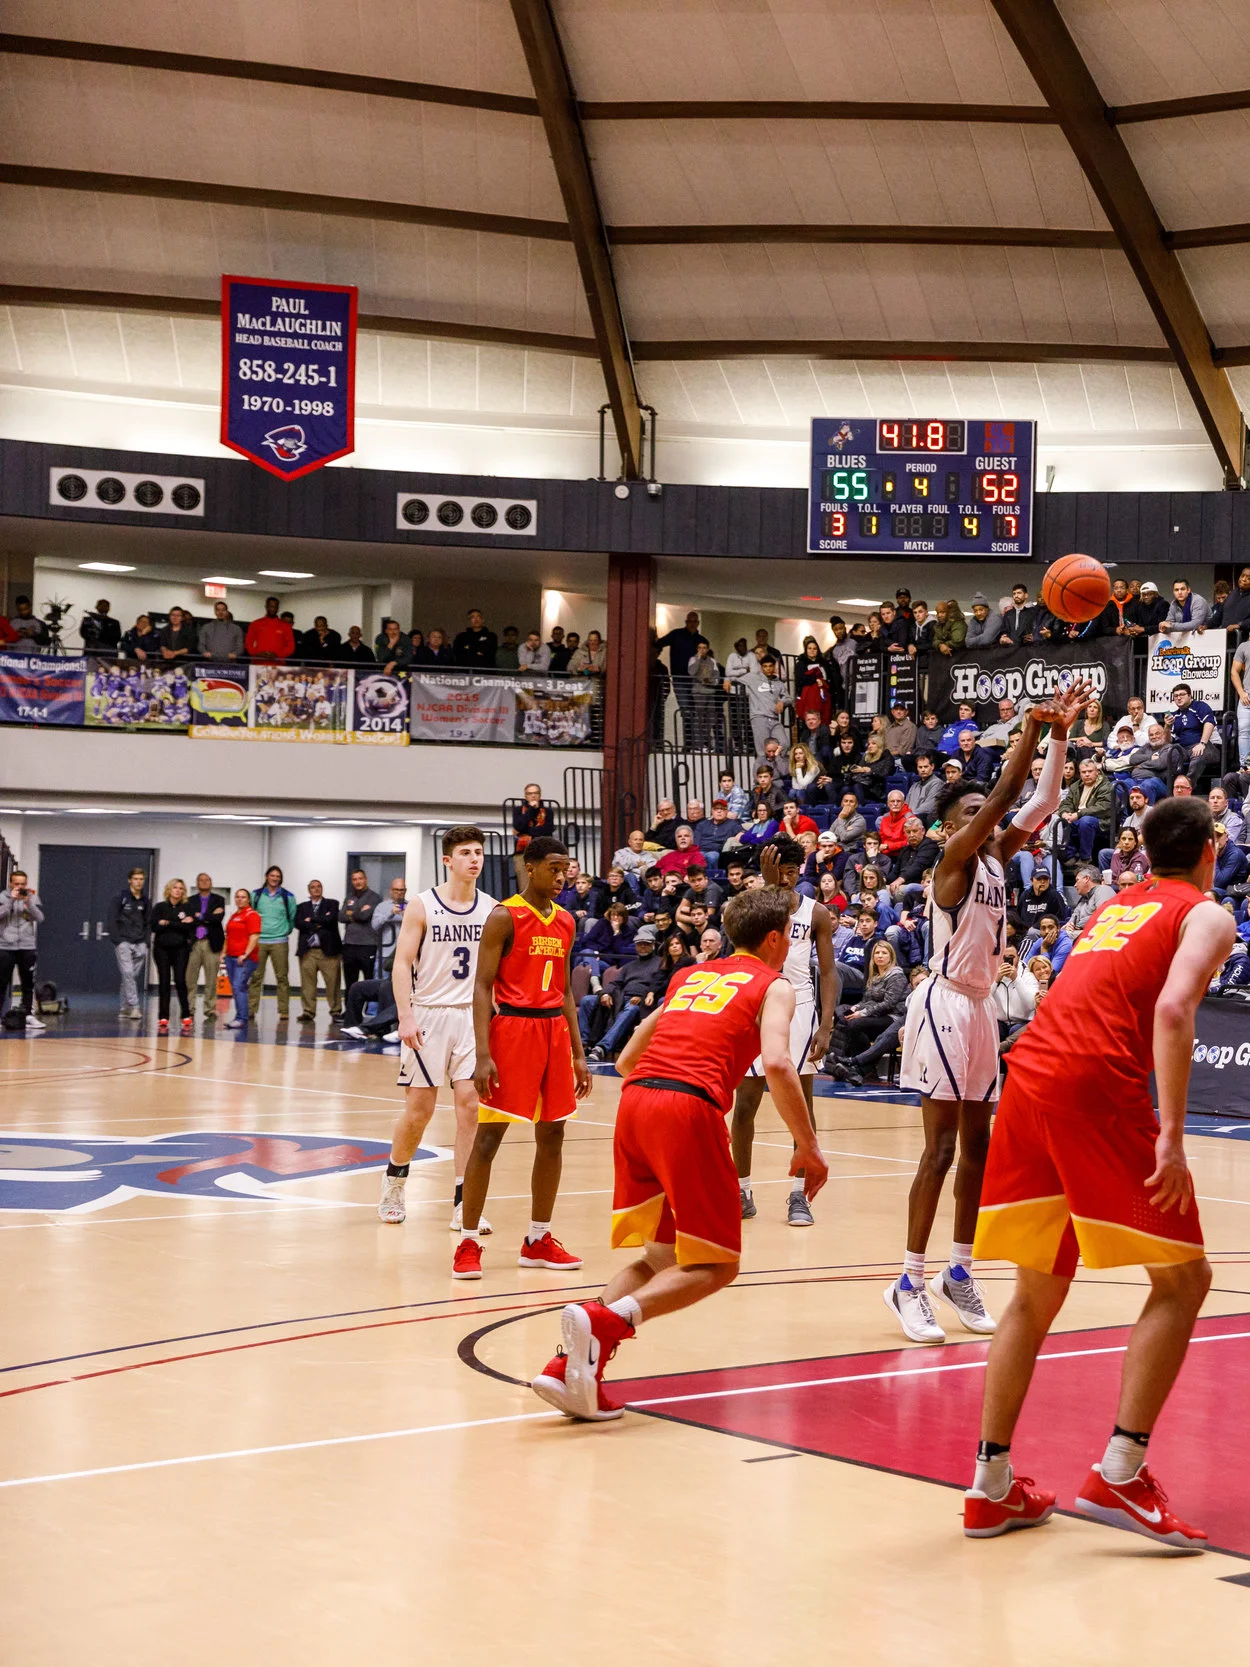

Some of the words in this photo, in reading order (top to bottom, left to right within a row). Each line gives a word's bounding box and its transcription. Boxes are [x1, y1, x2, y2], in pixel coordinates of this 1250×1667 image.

[271, 296, 309, 314] PAUL
[235, 333, 262, 345] HEAD
[263, 336, 310, 349] BASEBALL
[311, 340, 343, 351] COACH
[238, 358, 337, 387] 858-245-1
[242, 395, 334, 416] 1970-1998
[882, 423, 943, 450] 41.8
[826, 455, 867, 468] BLUES
[905, 463, 937, 473] PERIOD
[975, 457, 1018, 470] GUEST
[833, 472, 868, 499] 55
[914, 478, 928, 496] 4
[982, 475, 1018, 502] 52
[820, 503, 848, 512] FOULS
[857, 503, 881, 512] T.O.L.
[890, 504, 923, 514] PLAYER
[927, 504, 950, 514] FOUL
[958, 505, 982, 514] T.O.L.
[992, 505, 1020, 515] FOULS
[832, 513, 845, 536] 3
[871, 515, 877, 535] 1
[963, 517, 978, 536] 4
[1004, 516, 1016, 536] 7
[819, 540, 847, 549] SCORE
[903, 541, 934, 550] MATCH
[991, 542, 1019, 552] SCORE
[1159, 646, 1190, 656] Boardwalk
[0, 654, 28, 669] tional
[420, 674, 470, 686] National
[472, 677, 534, 689] Champions
[546, 681, 554, 690] 3
[556, 681, 583, 691] Peat
[1181, 669, 1219, 680] Showcase
[447, 693, 479, 702] 2015
[17, 705, 48, 718] 17-1-1
[417, 703, 453, 713] NJCAA
[456, 704, 496, 714] Division
[360, 717, 402, 731] 2014
[974, 882, 1006, 908] RAN
[432, 925, 484, 942] RANNE
[1071, 902, 1162, 956] 32
[531, 936, 563, 948] BERGEN
[528, 946, 565, 958] CATHOLIC
[452, 947, 470, 979] 3
[542, 960, 553, 992] 1
[664, 970, 754, 1014] 25
[1191, 1038, 1234, 1069] oop
